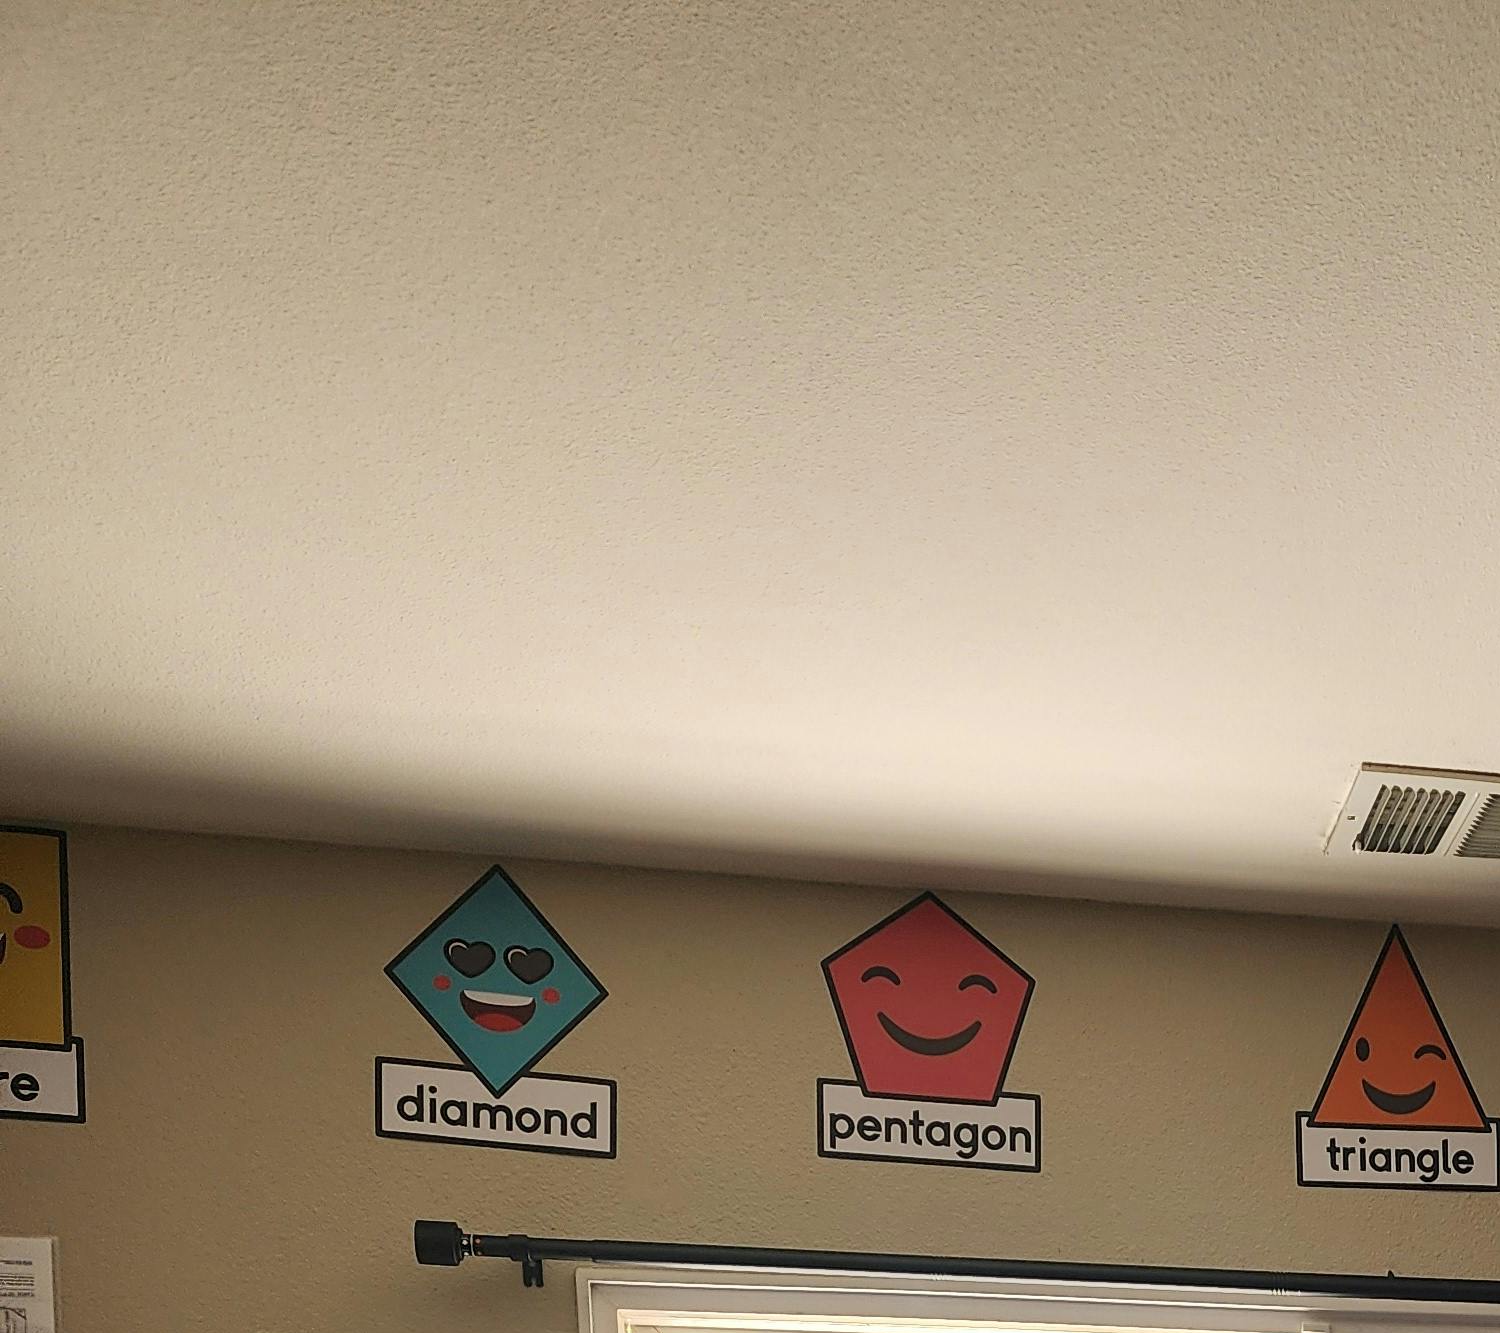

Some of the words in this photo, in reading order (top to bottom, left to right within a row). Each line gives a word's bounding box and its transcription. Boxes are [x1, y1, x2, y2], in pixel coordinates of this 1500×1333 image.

[396, 1084, 598, 1139] diamond
[829, 1109, 1032, 1159] pentagon
[1326, 1136, 1475, 1183] triangle
